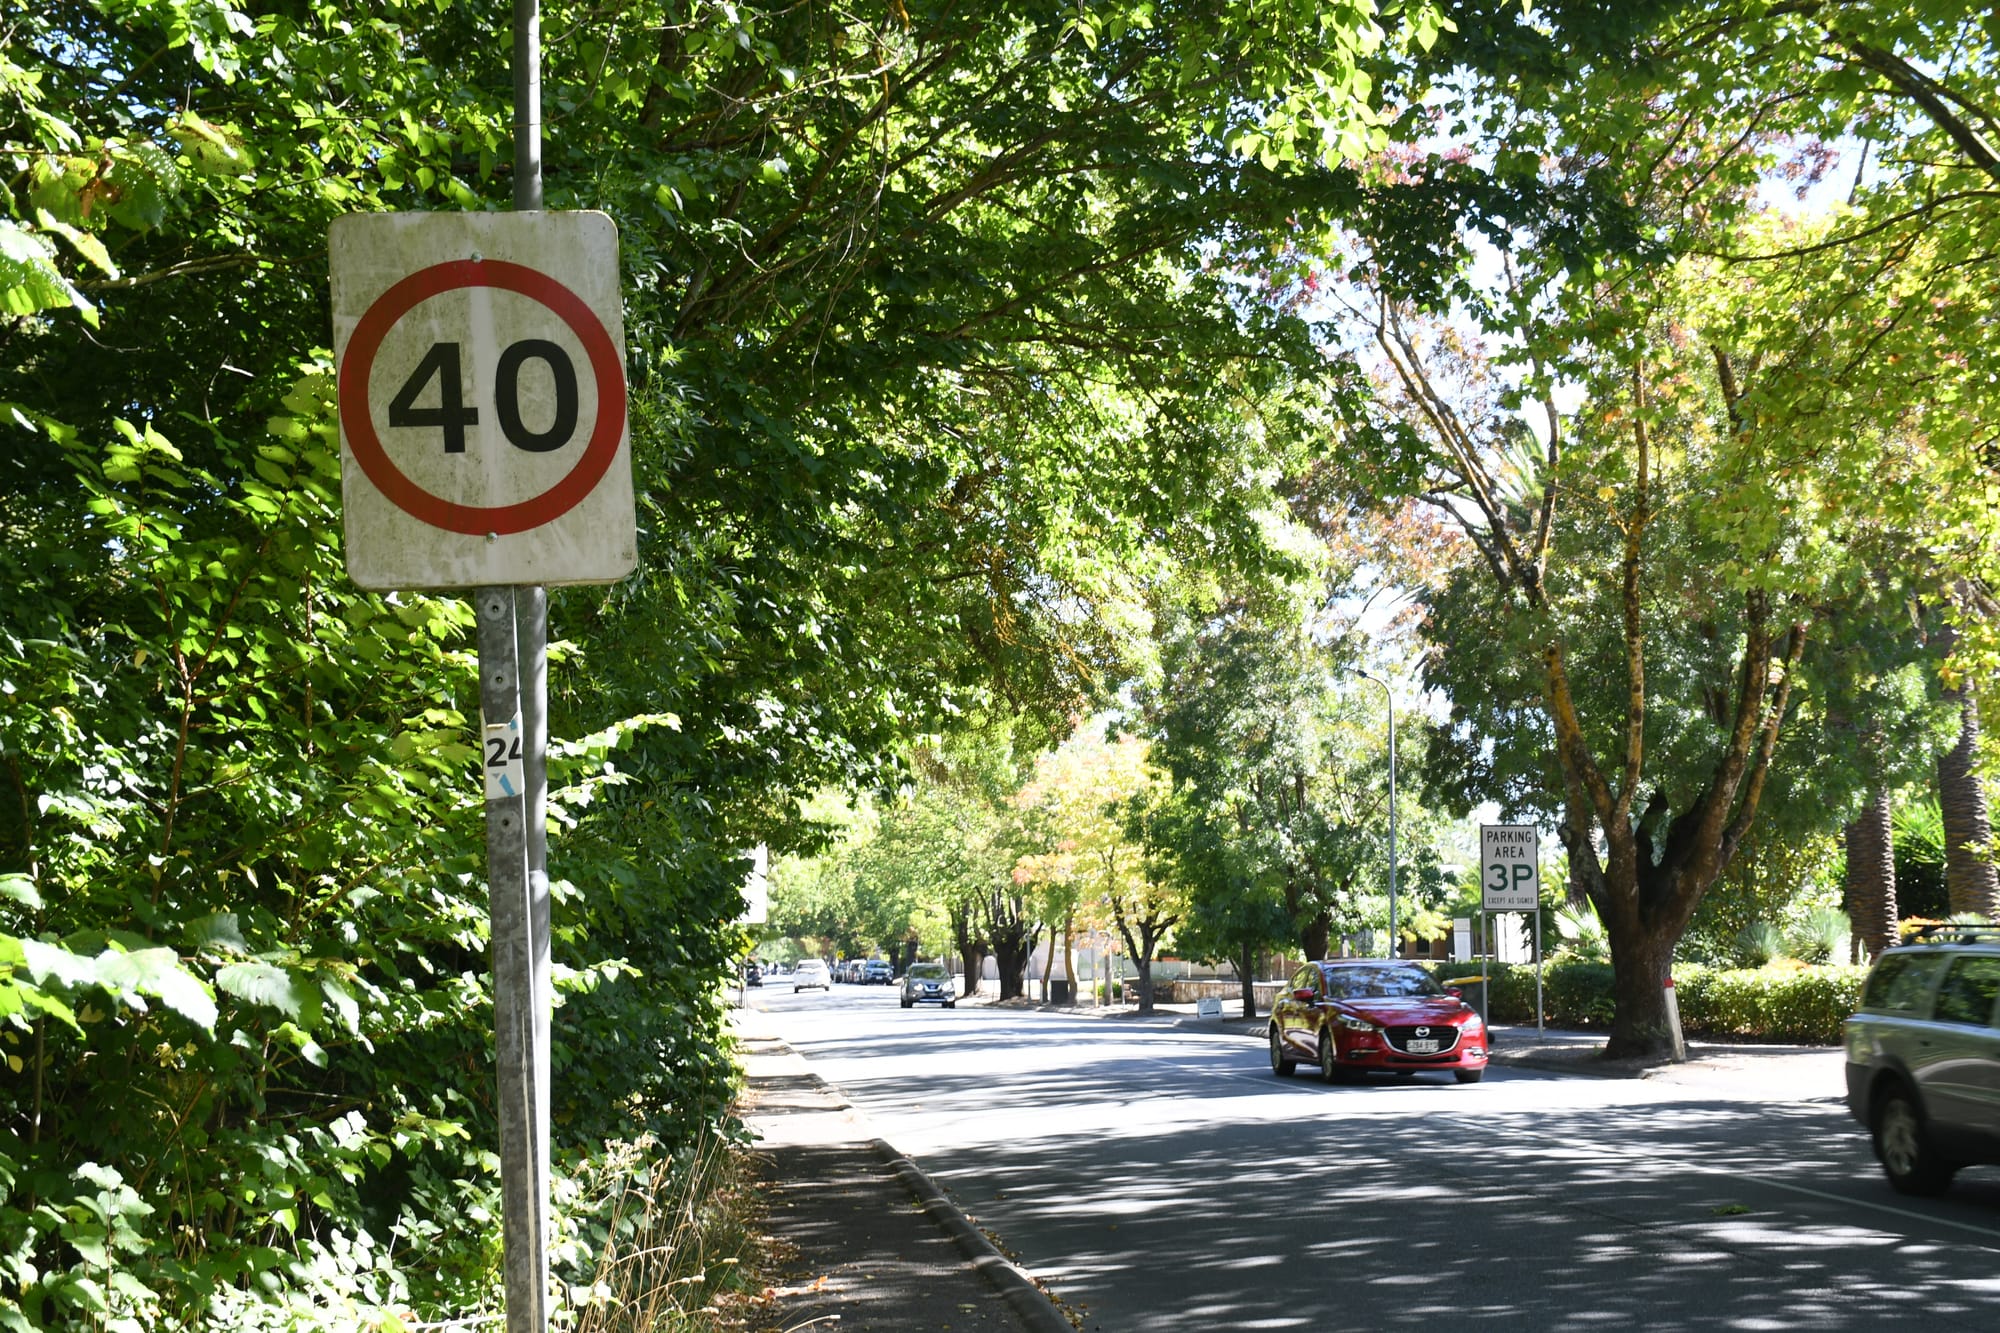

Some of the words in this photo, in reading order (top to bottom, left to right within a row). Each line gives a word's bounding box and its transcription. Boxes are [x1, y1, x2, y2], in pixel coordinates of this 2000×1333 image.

[389, 339, 578, 453] 40
[1487, 831, 1532, 843] PARKING
[1494, 846, 1525, 858] AREA
[1488, 864, 1533, 891] 3P
